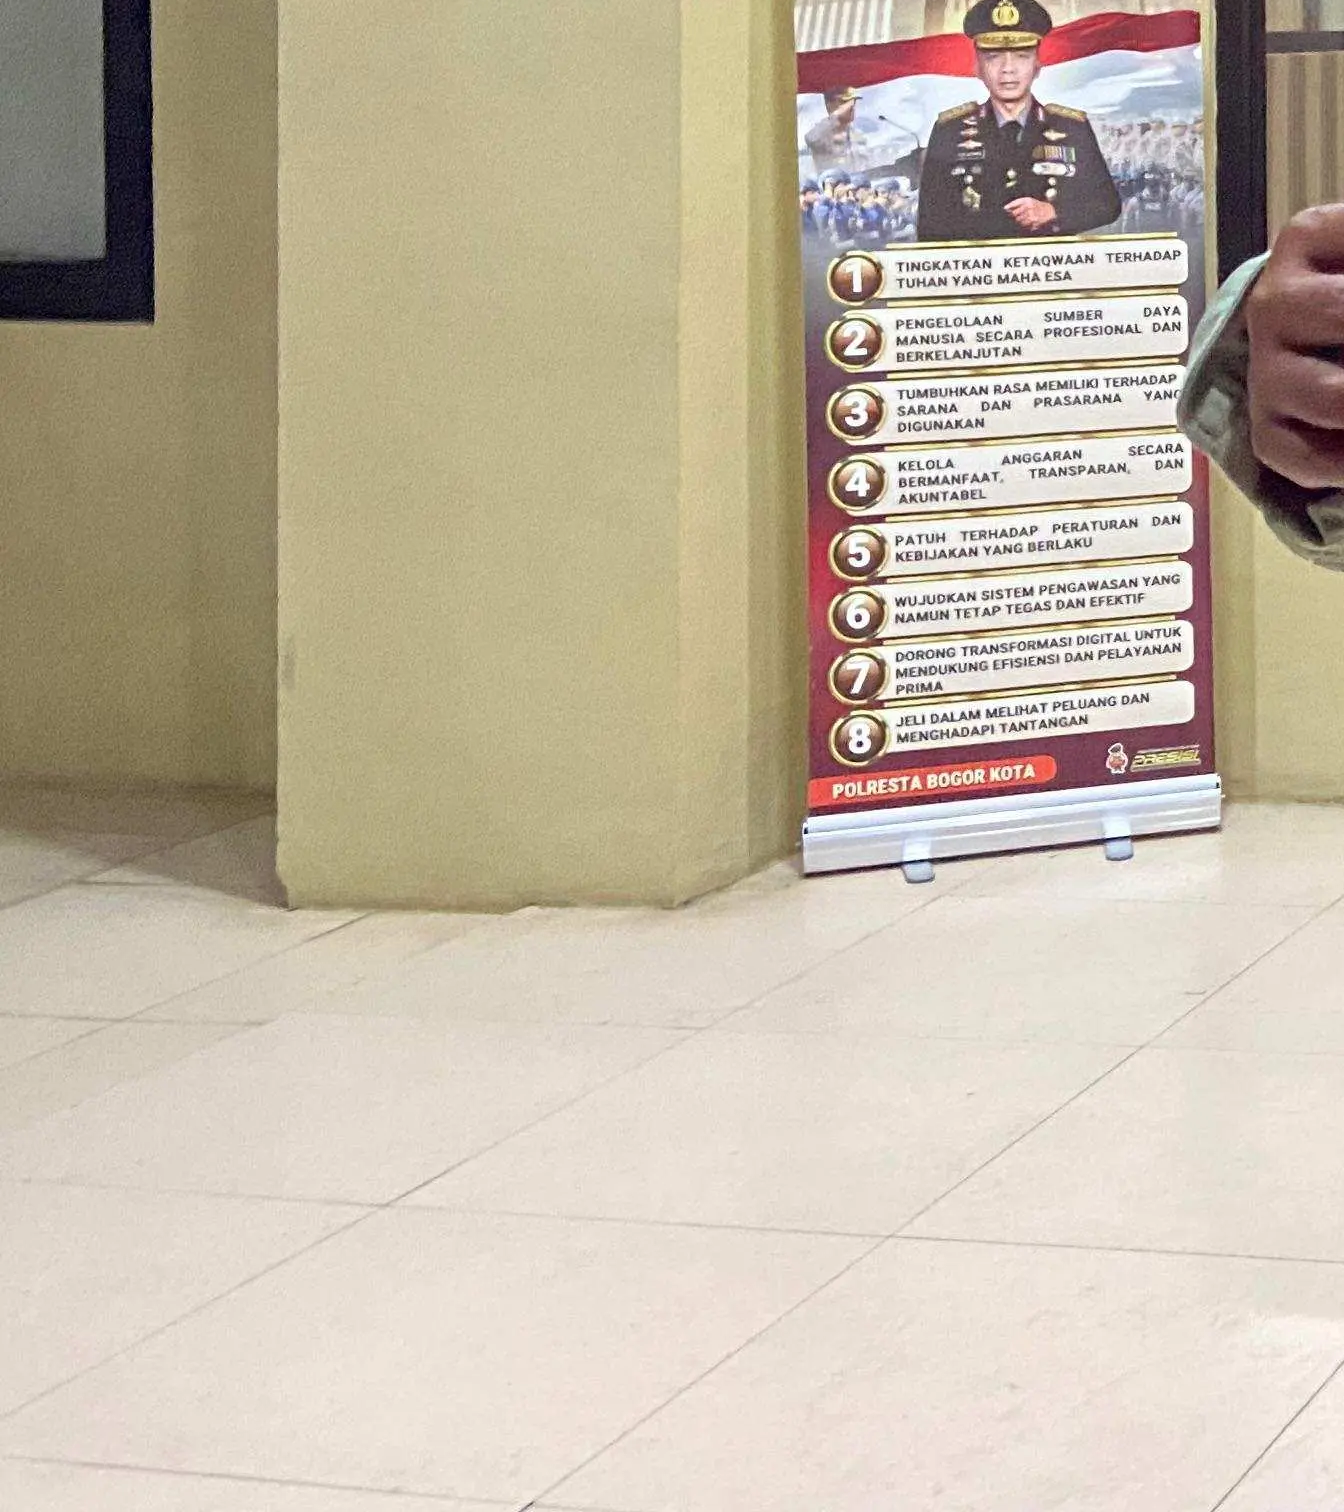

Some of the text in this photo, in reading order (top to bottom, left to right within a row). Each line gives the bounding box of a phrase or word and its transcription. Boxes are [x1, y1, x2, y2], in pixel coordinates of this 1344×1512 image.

[898, 250, 1181, 272] TINGKATKAN KETAQWAAN TERHADAP
[847, 262, 863, 293] 1
[897, 270, 1072, 288] TUHAN YANG MAHA ESA
[896, 306, 1181, 329] PENGELOLAAN SUMBER DAYA
[844, 325, 867, 356] 2
[896, 322, 1181, 346] MANUSIA SECARA PROFESIONAL DAN
[896, 346, 1022, 362] BERKELANJUTAN
[898, 374, 1177, 400] TUMBUHKAN RASA MEMILIKI TERHADAP
[845, 397, 869, 427] 3
[897, 403, 957, 416] SARANA
[981, 400, 1011, 411] DAN
[1034, 393, 1121, 408] PRASARANA
[898, 418, 985, 432] DIGUNAKAN
[898, 443, 1183, 471] KELOLA ANGGARAN SECARA
[1155, 459, 1183, 471] DAN
[845, 468, 870, 497] 4
[899, 490, 986, 504] AKUNTABEL
[895, 514, 1181, 545] PATUH TERHADAP PERATURAN DAN
[847, 536, 870, 567] 5
[895, 538, 1092, 561] KEBIJAKAN YANG BERLAKU
[895, 574, 1181, 607] WUJUDKAN SISTEM PENGAWASAN YANG
[846, 598, 870, 629] 6
[895, 593, 1145, 624] NAMUN TETAP TEGAS DAN EFEKTIF
[896, 627, 1182, 661] DORONG TRANSFORMASI DIGITAL UNTUK
[896, 642, 1182, 679] MENDUKUNG EFISIENSI DAN PELAYANAN
[847, 662, 870, 694] 7
[896, 682, 942, 695] PRIMA
[896, 692, 1150, 726] JELI DALAM MELIHAT PELUANG DAN
[848, 723, 872, 753] 8
[896, 715, 1088, 744] MENGHADAPI TANTANGAN
[832, 766, 1035, 798] POLRESTA BOGOR KOTA
